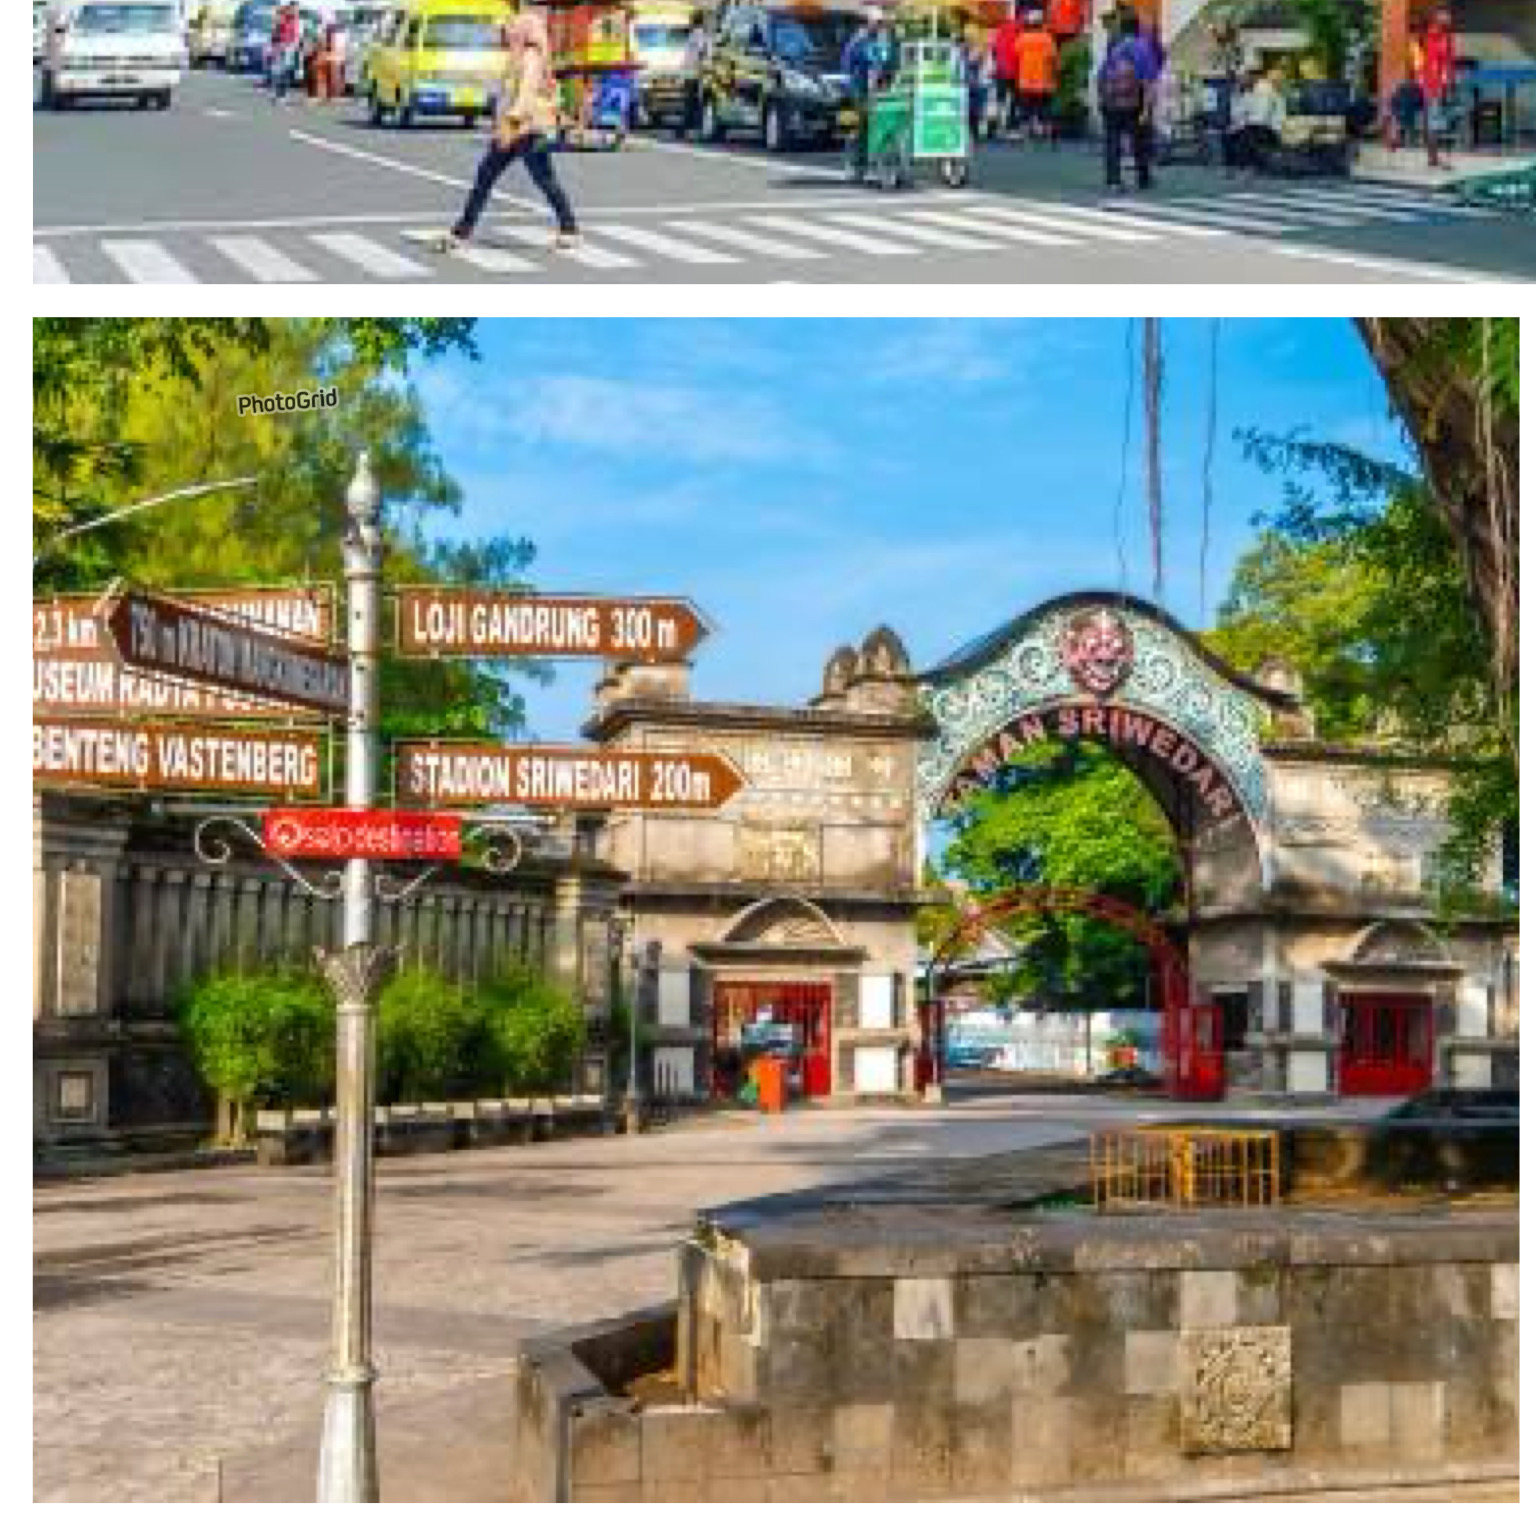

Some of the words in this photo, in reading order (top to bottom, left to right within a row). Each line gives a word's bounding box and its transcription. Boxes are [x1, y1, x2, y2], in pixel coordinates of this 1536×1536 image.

[413, 599, 467, 646] LOJI
[472, 602, 599, 649] GANDRUNG
[610, 606, 653, 650] 300
[656, 617, 679, 650] m
[157, 733, 318, 786] VASTENBERG
[409, 754, 510, 801] STADION
[515, 757, 640, 801] SRIWEDARI
